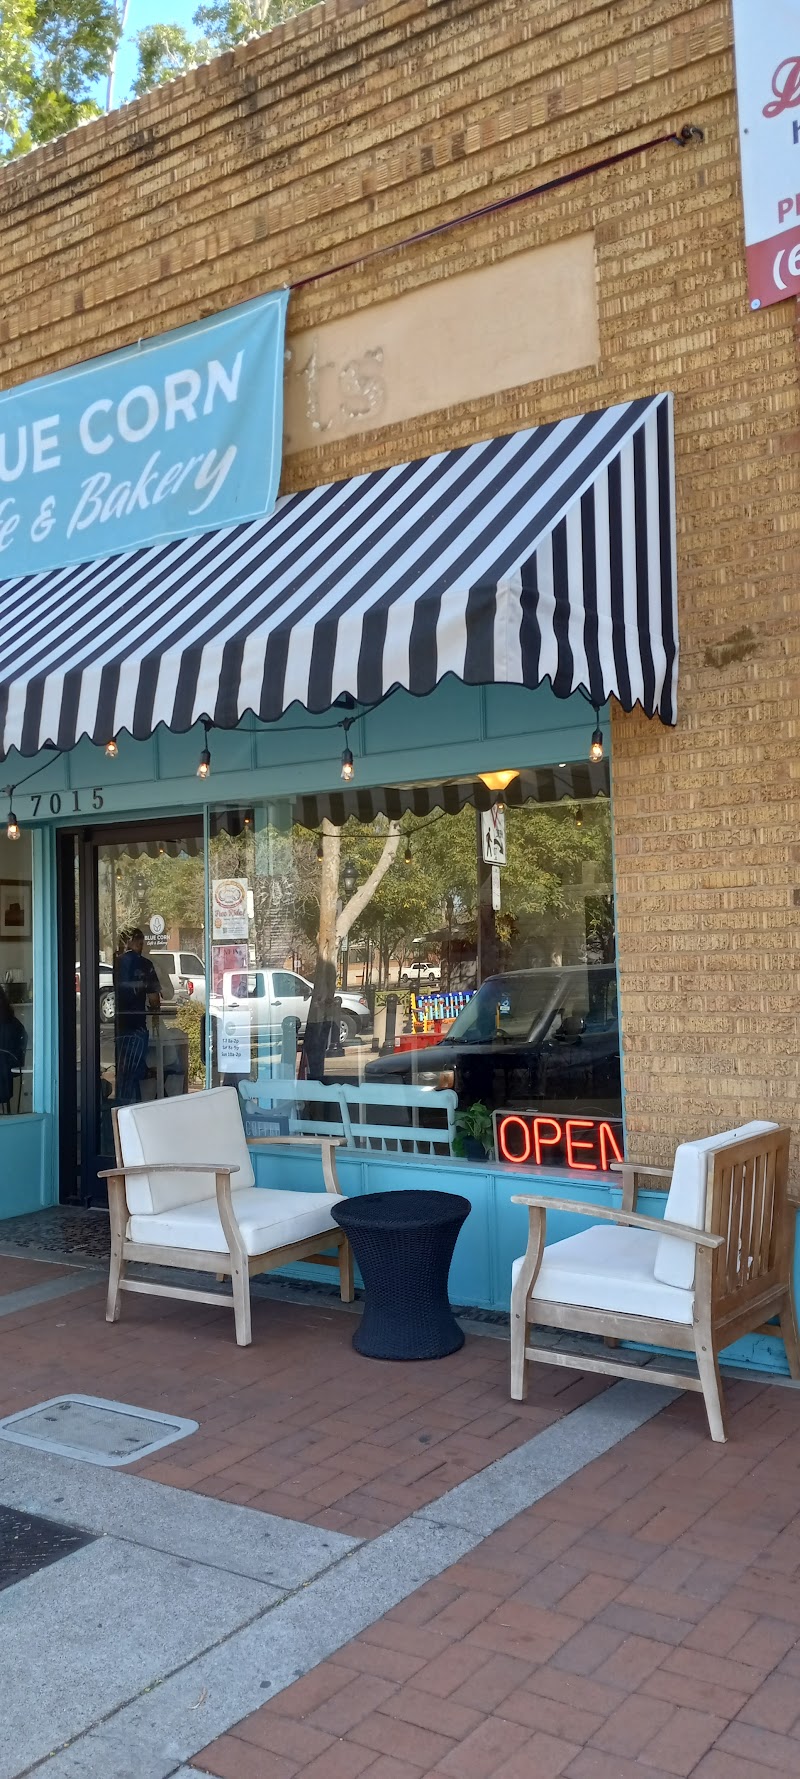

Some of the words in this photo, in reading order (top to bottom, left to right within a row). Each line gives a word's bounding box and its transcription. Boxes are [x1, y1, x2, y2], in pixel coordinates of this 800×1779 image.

[79, 349, 245, 455] CORN
[30, 495, 56, 543] &
[66, 445, 237, 539] Bakery
[31, 787, 104, 817] 7015
[499, 1115, 624, 1172] OPEN
